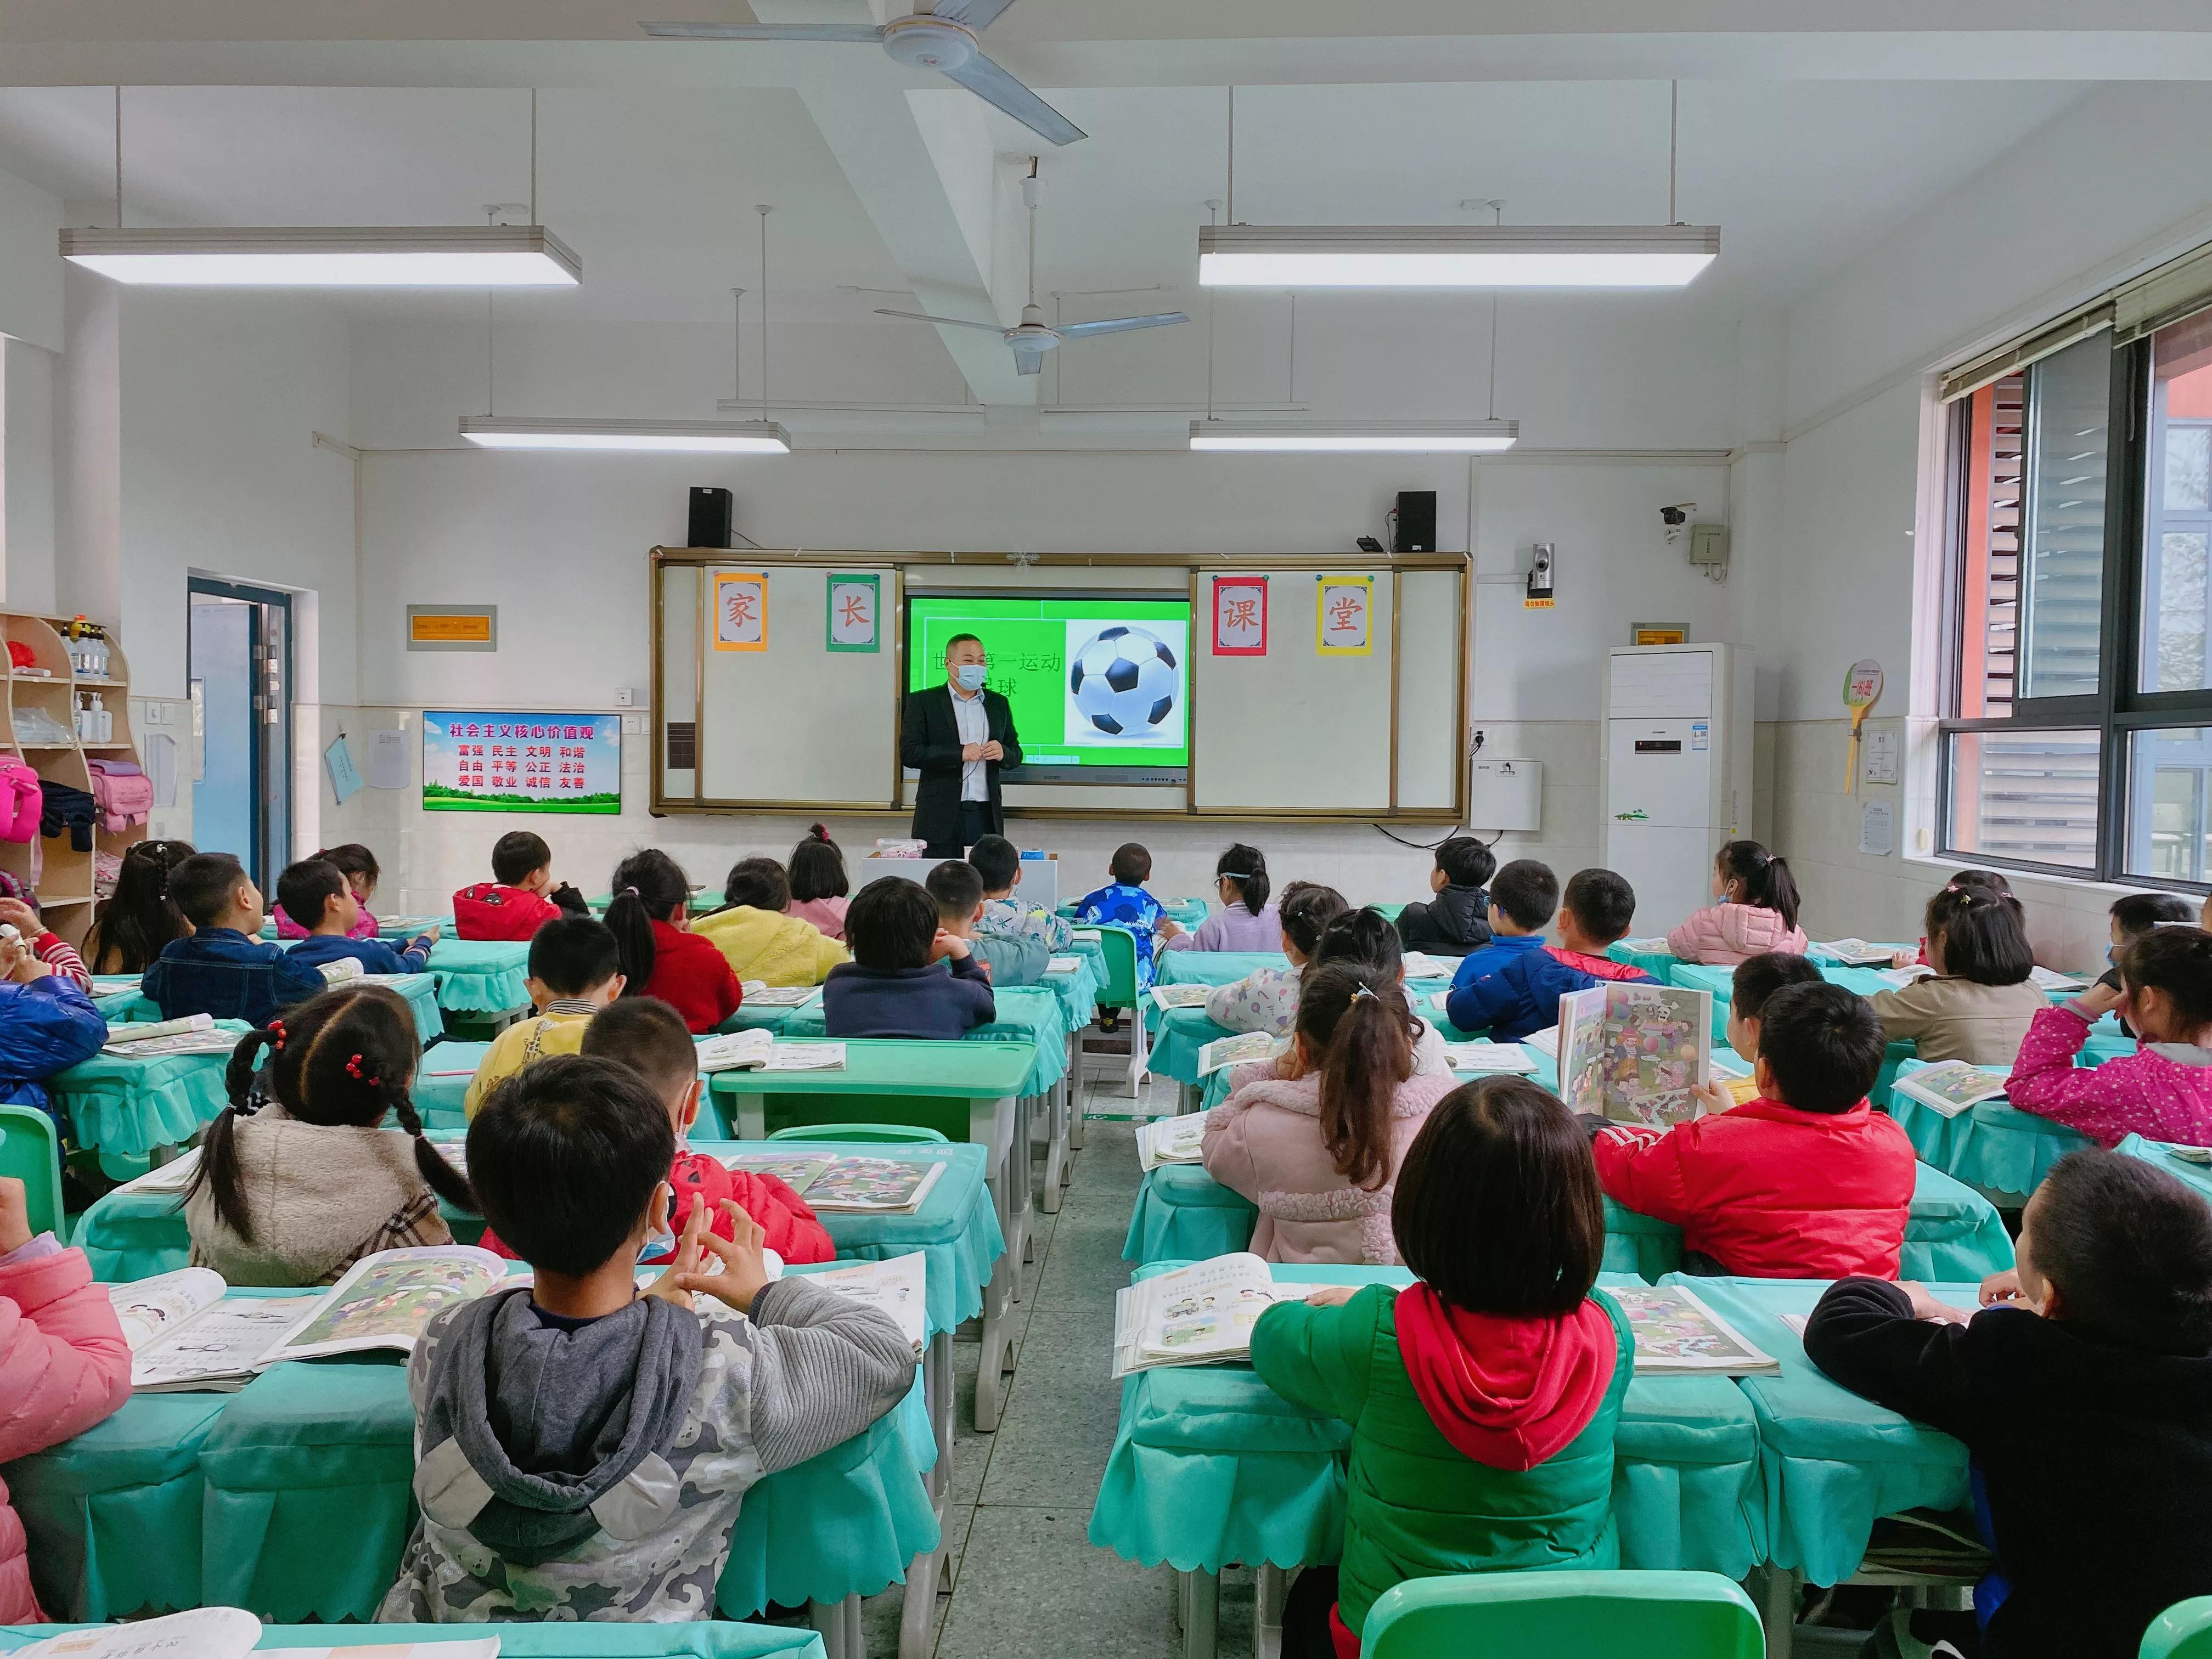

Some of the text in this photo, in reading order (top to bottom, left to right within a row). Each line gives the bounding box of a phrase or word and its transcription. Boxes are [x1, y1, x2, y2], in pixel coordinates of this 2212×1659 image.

[727, 593, 1362, 632] 家 长 课 堂
[933, 651, 1061, 673] 世第一运动
[449, 724, 594, 740] 社会主义核心价值观
[458, 744, 585, 759] 富强 民主 文明 和谐
[459, 760, 585, 774] 自由 平等 公正 法治
[458, 775, 585, 789] 爱国 敬业 诚信 友善
